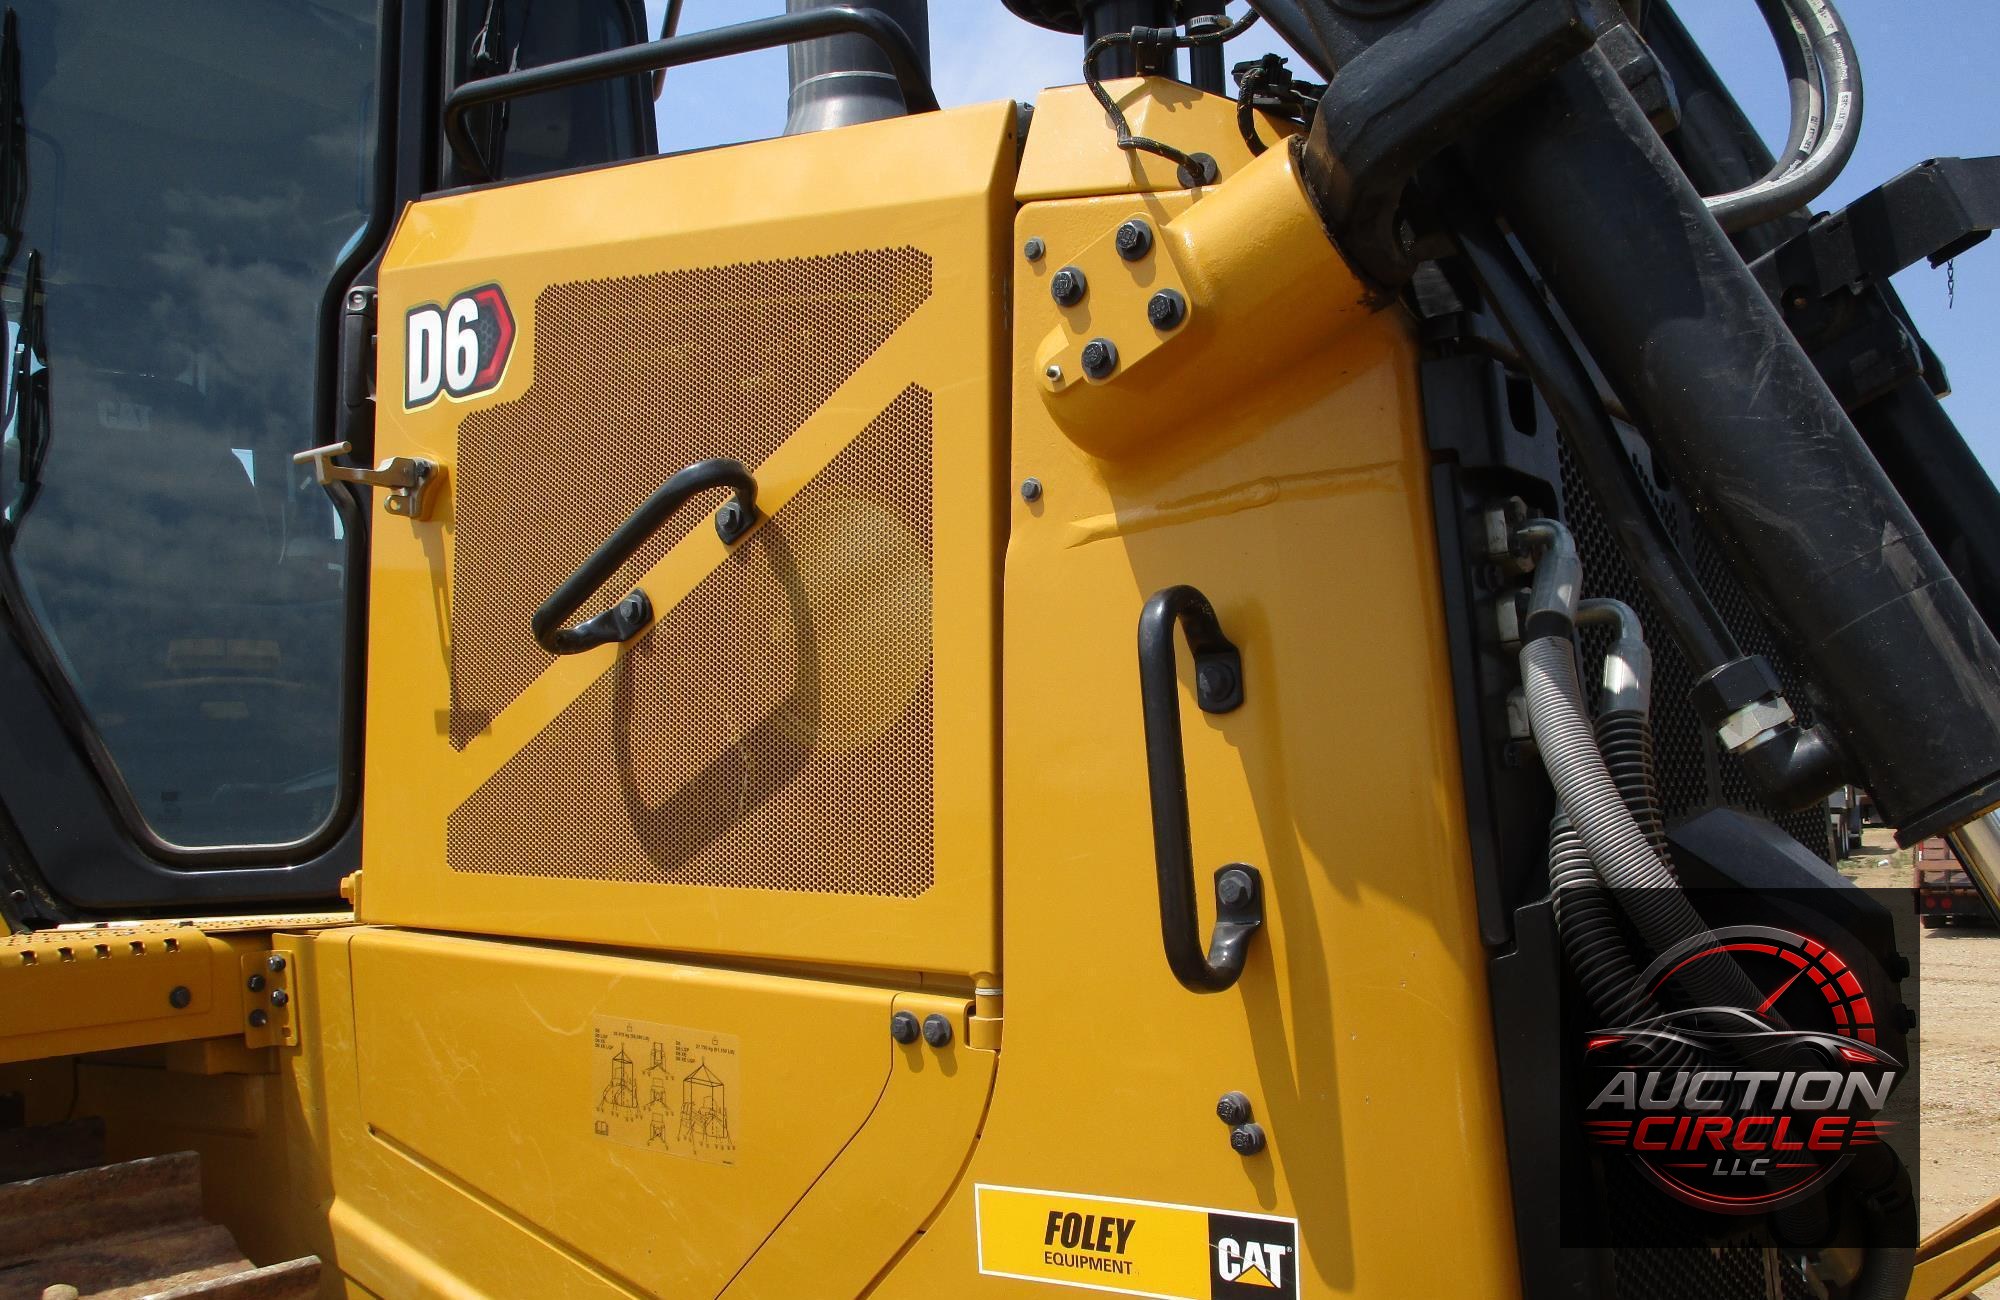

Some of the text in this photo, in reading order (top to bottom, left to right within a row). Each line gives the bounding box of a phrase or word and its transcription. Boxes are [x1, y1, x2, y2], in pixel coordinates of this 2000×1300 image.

[409, 298, 479, 402] D6
[1044, 1210, 1136, 1255] FOLEY
[1044, 1251, 1133, 1275] EQUIPMENT
[1218, 1237, 1286, 1289] CAT
